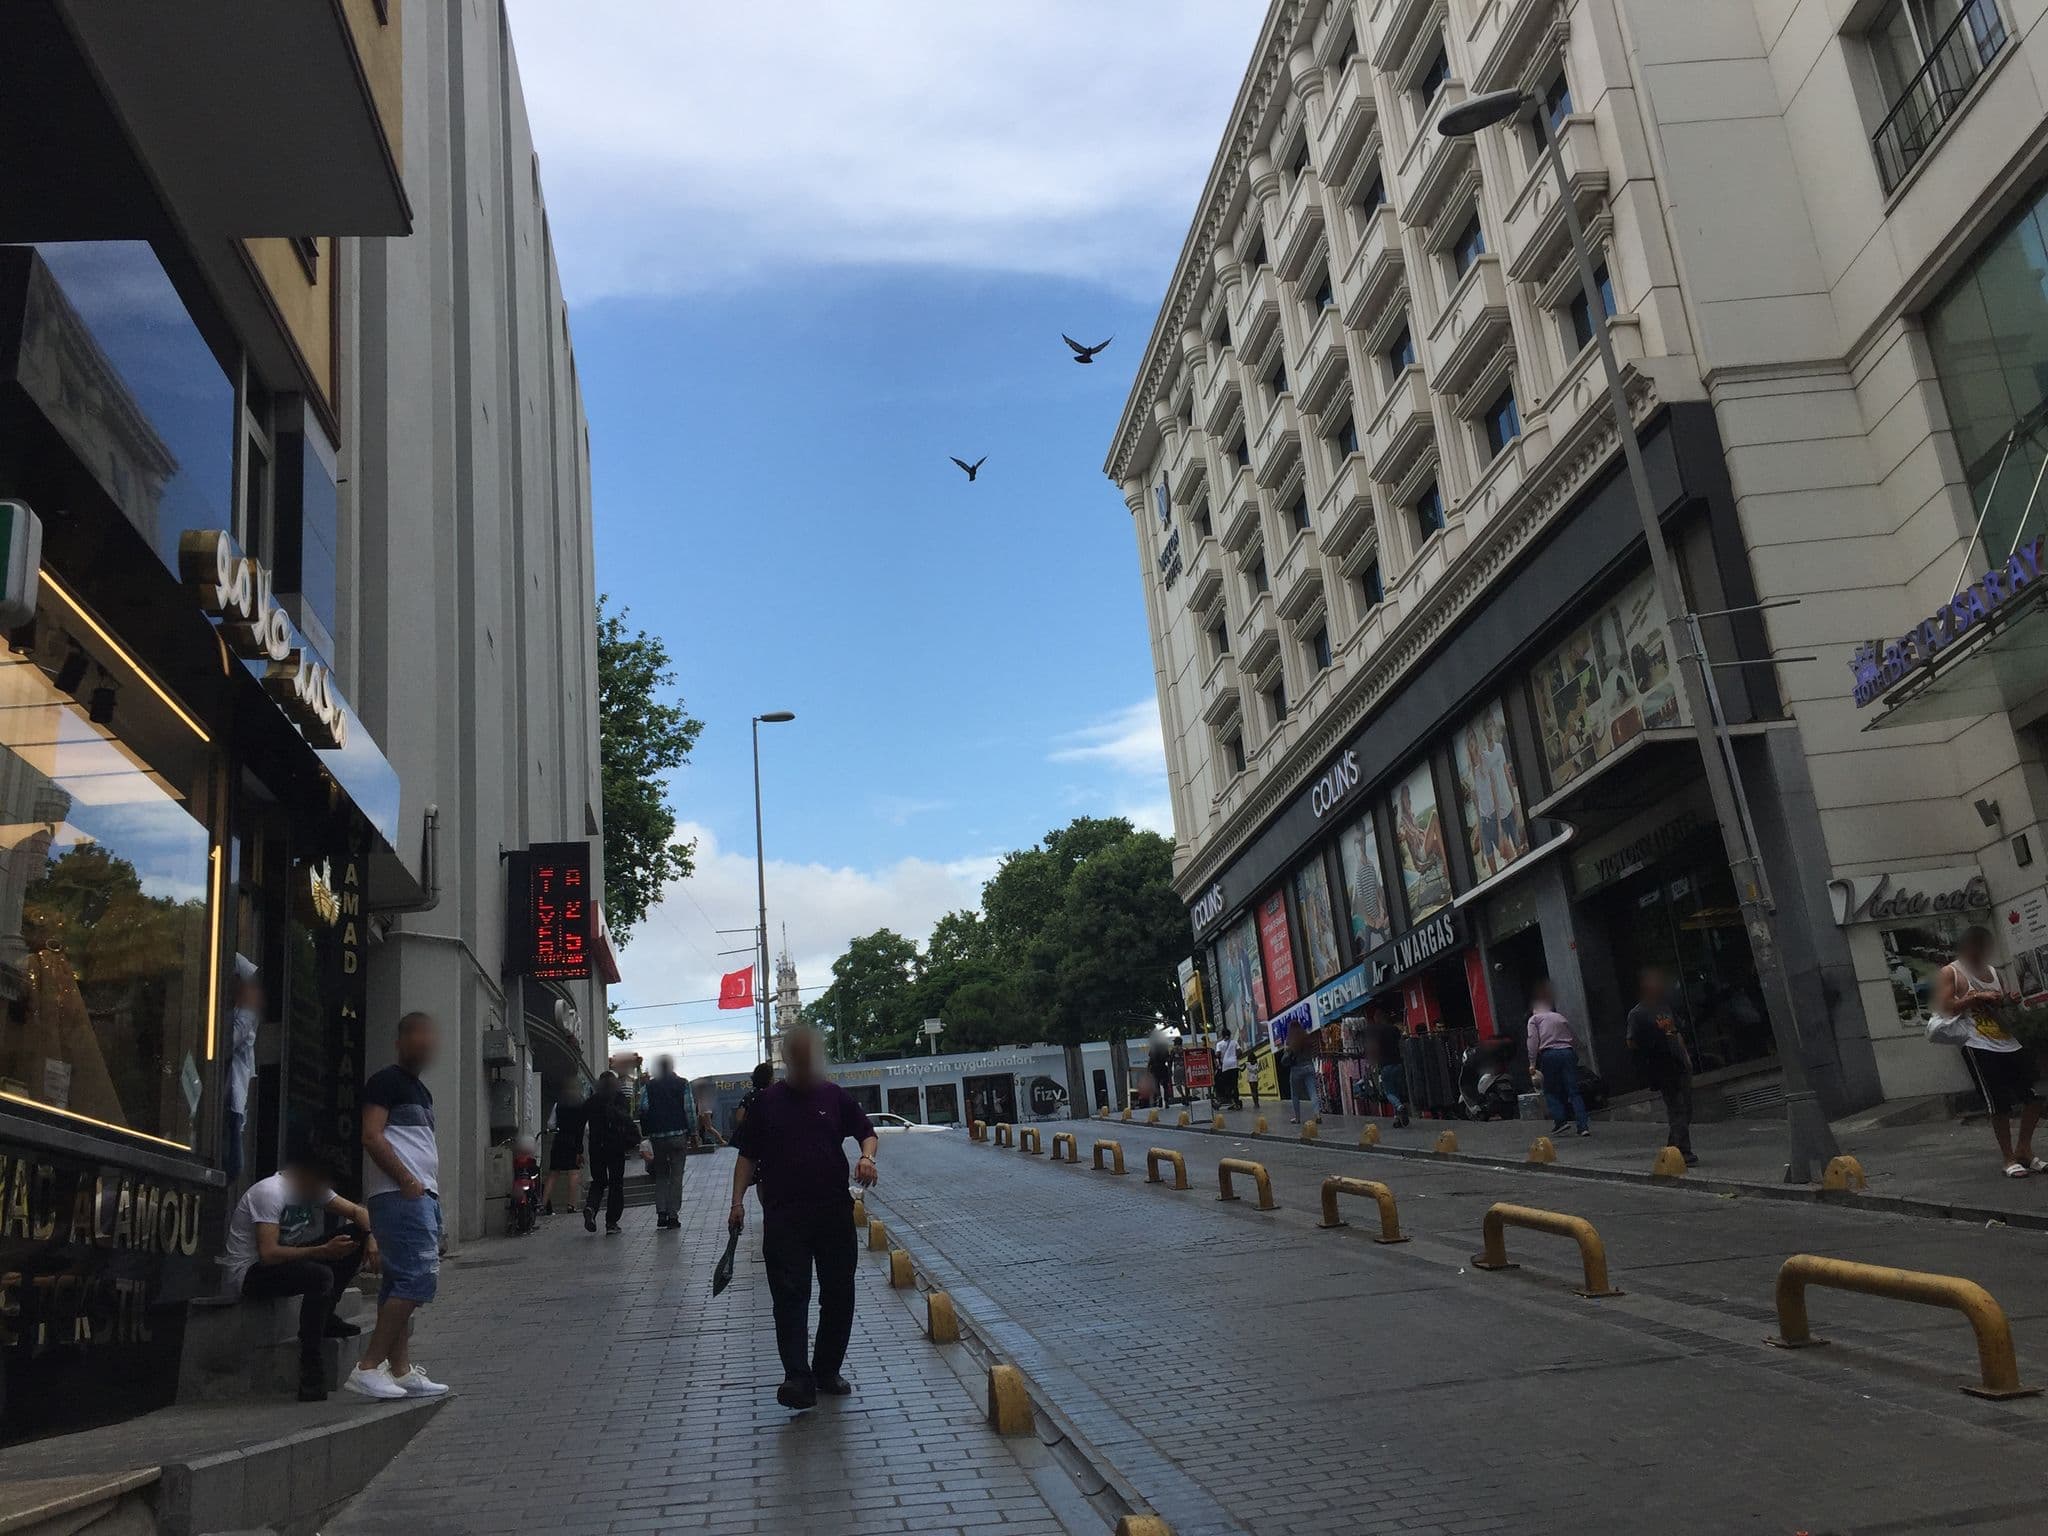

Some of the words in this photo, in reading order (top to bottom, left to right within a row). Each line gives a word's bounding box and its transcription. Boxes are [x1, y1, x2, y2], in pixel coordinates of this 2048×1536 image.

[1884, 537, 2044, 680] BEYAZSARAY
[1311, 749, 1360, 818] COLIN'S
[1393, 913, 1456, 975] J.WARGAS
[1033, 1085, 1063, 1102] fizy
